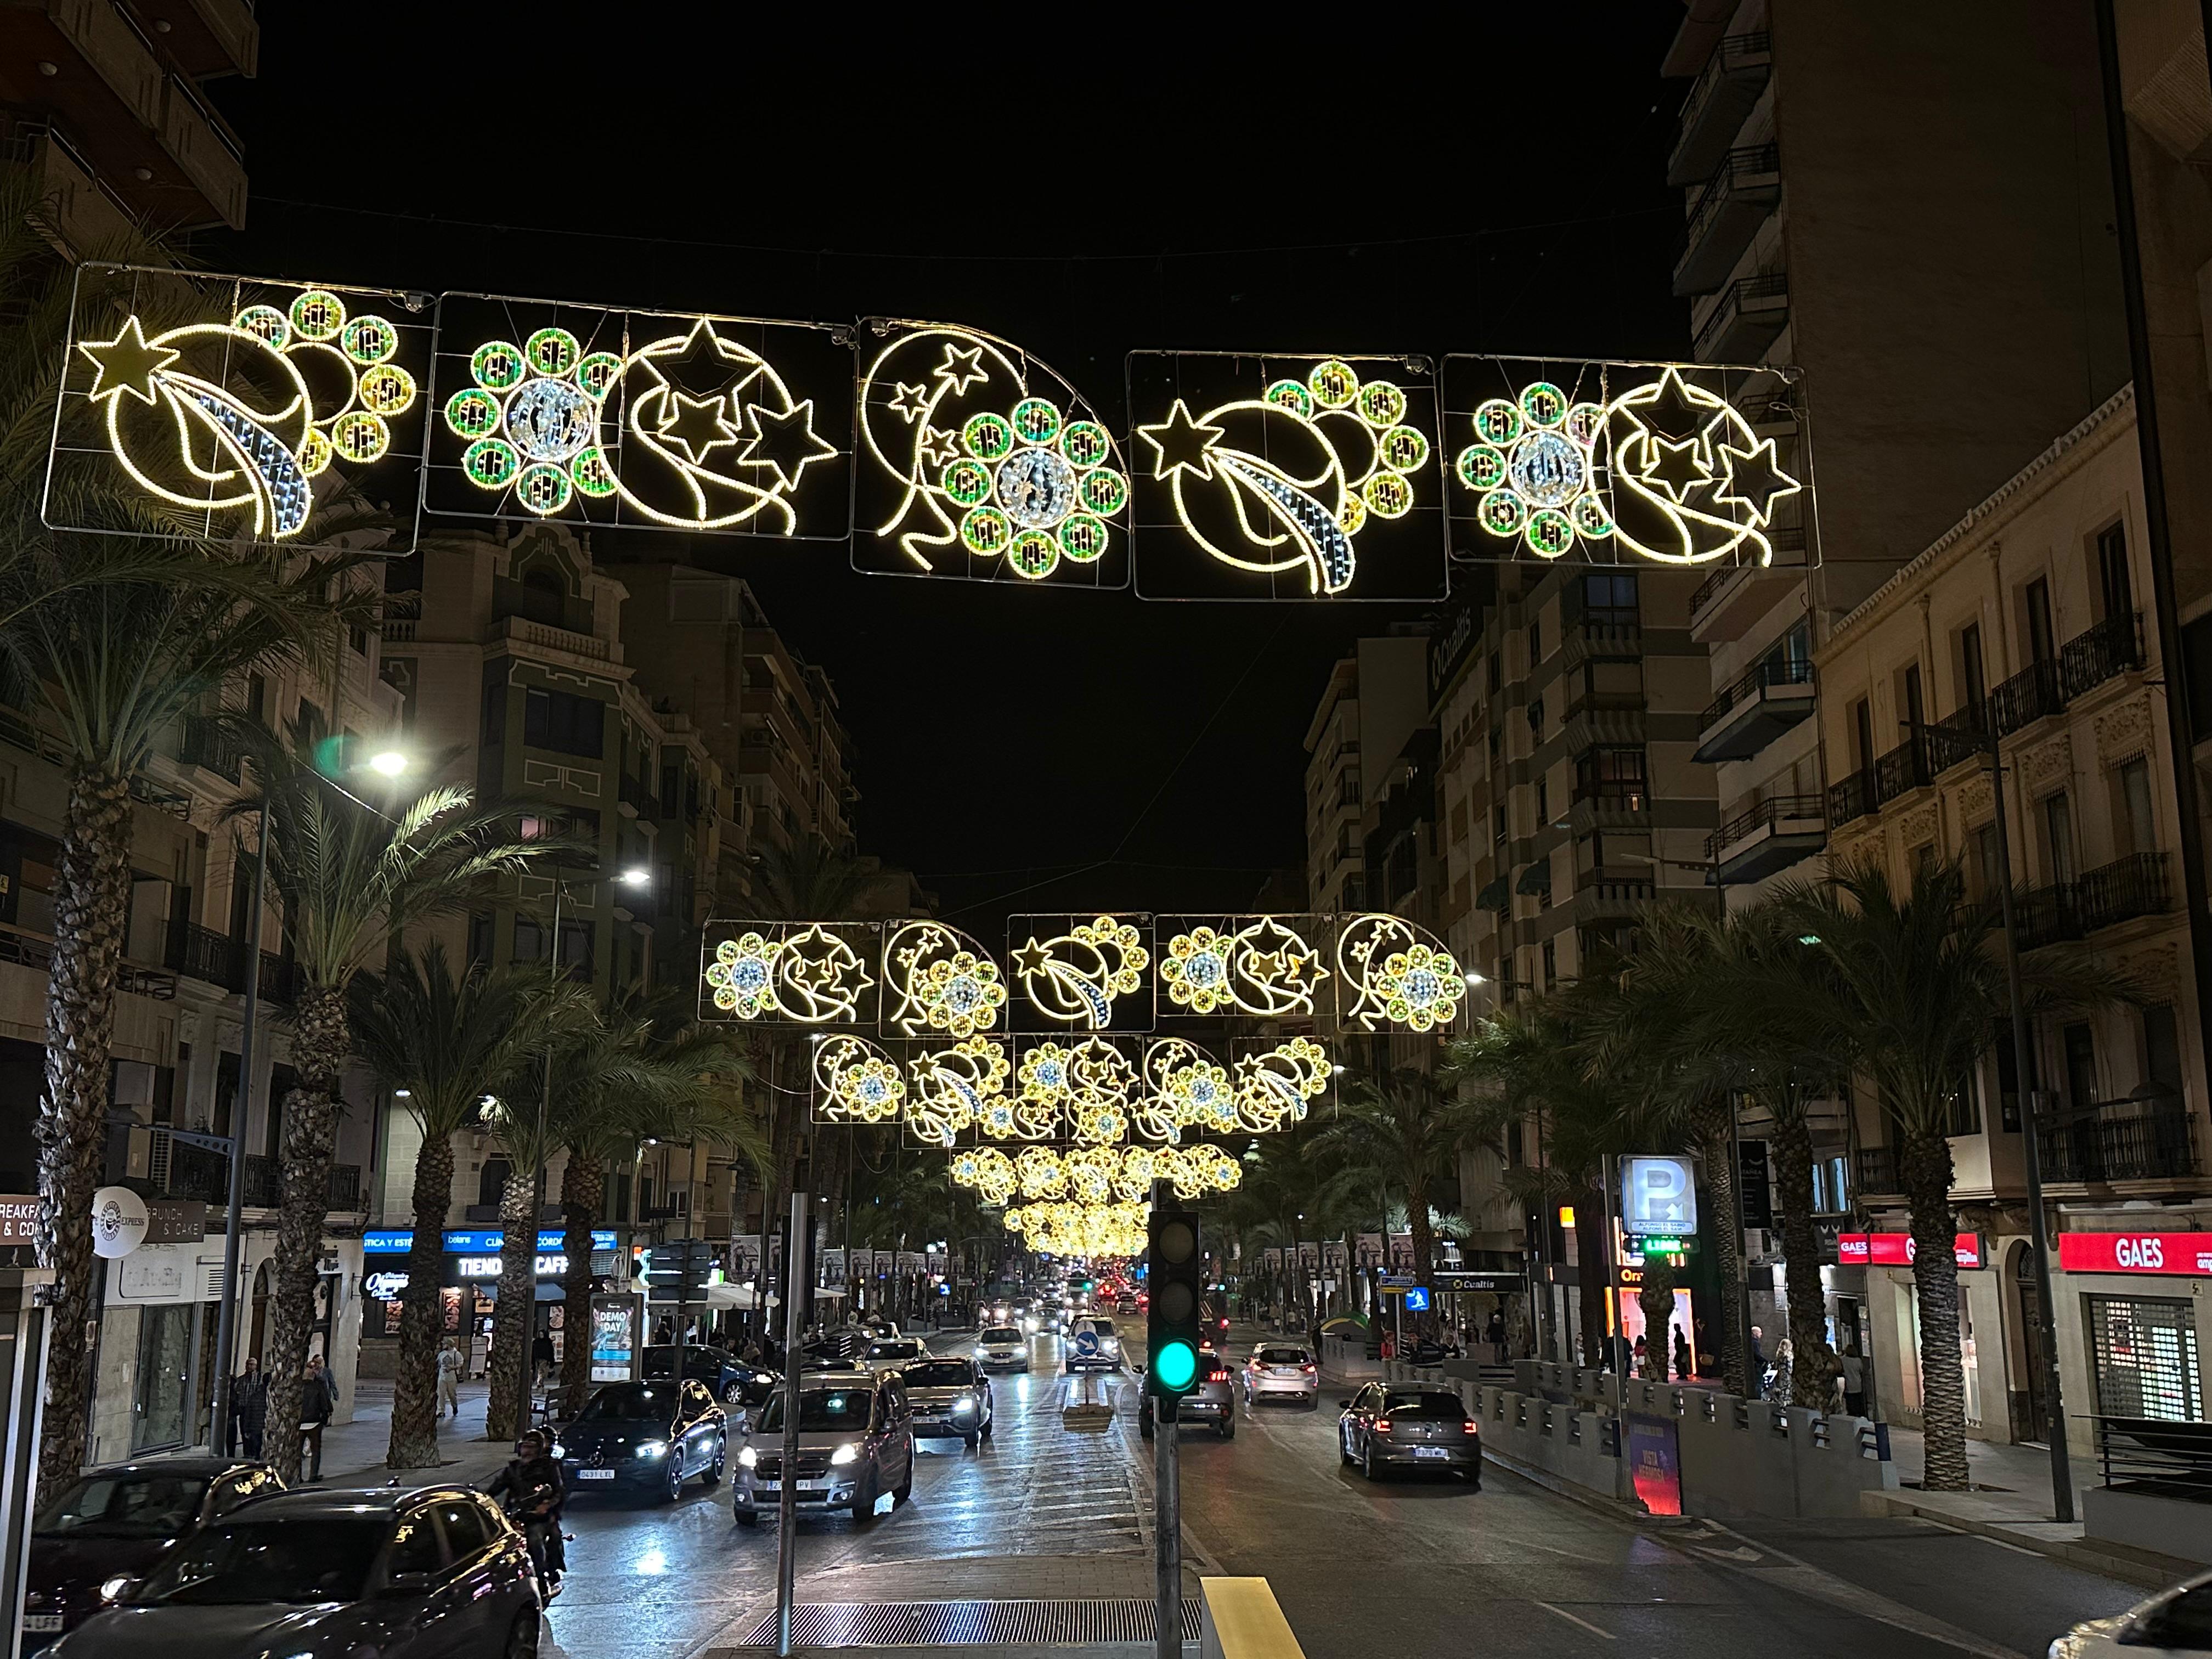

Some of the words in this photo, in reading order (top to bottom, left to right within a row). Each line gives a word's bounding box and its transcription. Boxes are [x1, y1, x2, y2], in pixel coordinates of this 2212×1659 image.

[1632, 1159, 1686, 1220] P
[121, 1217, 144, 1226] EXPRESS
[4, 1221, 12, 1236] &
[176, 1223, 199, 1235] CAKE
[1841, 1242, 1867, 1251] GAES
[2115, 1238, 2163, 1268] GAES
[459, 1258, 503, 1276] TIEND
[600, 1312, 626, 1322] DEMO
[604, 1322, 621, 1332] DAY
